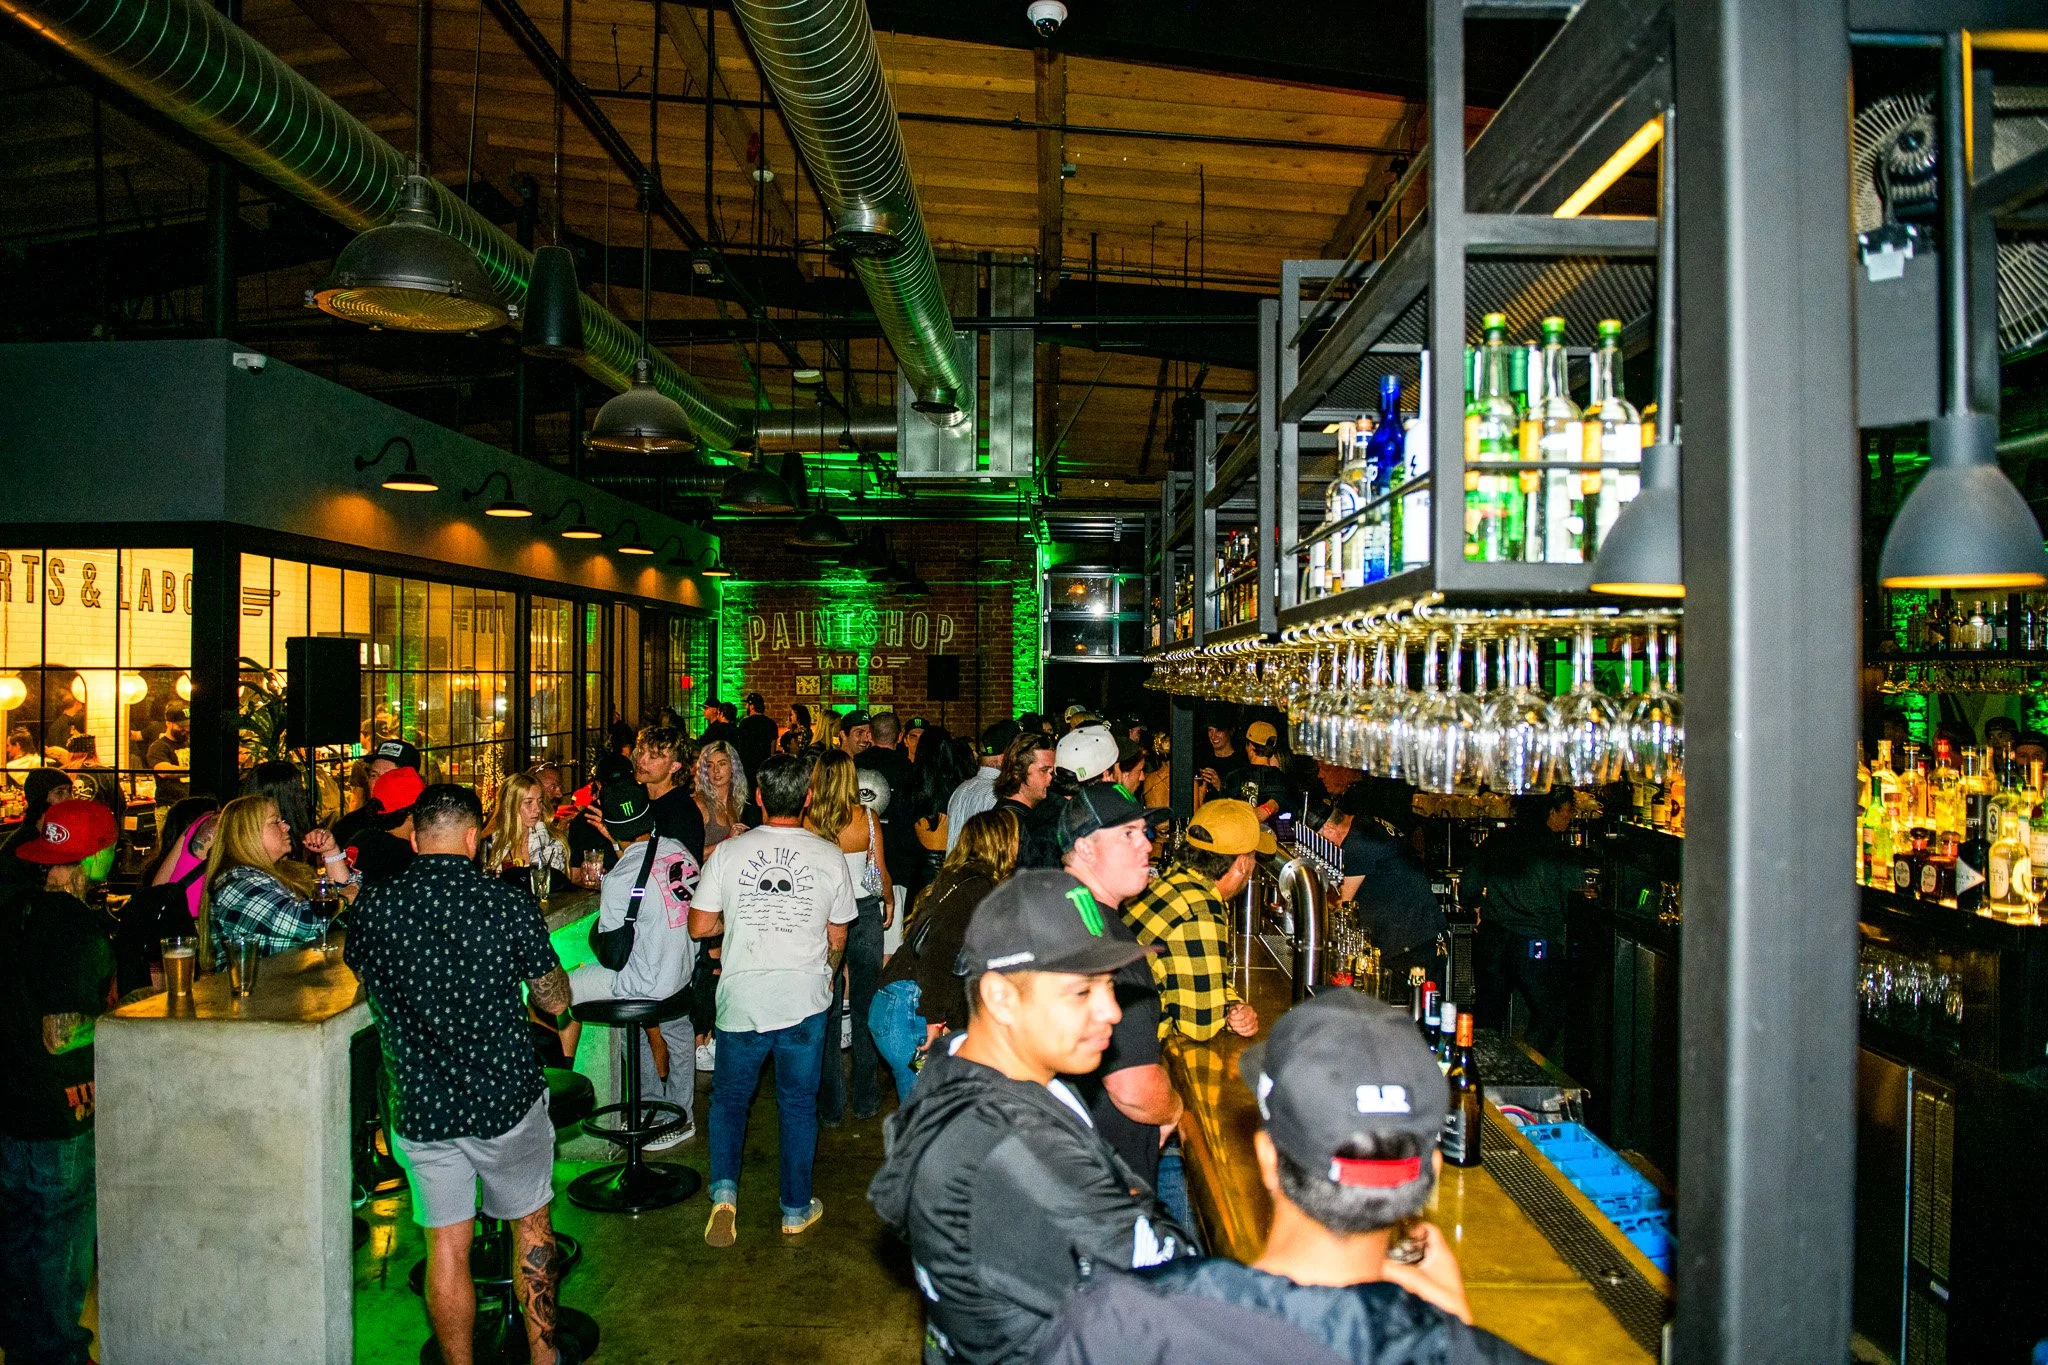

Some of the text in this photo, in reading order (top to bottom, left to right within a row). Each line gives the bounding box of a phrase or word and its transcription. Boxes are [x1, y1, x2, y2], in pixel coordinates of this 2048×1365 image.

[81, 562, 102, 608] &
[816, 655, 884, 670] TATTOO
[738, 847, 815, 893] FEAR THE SEA
